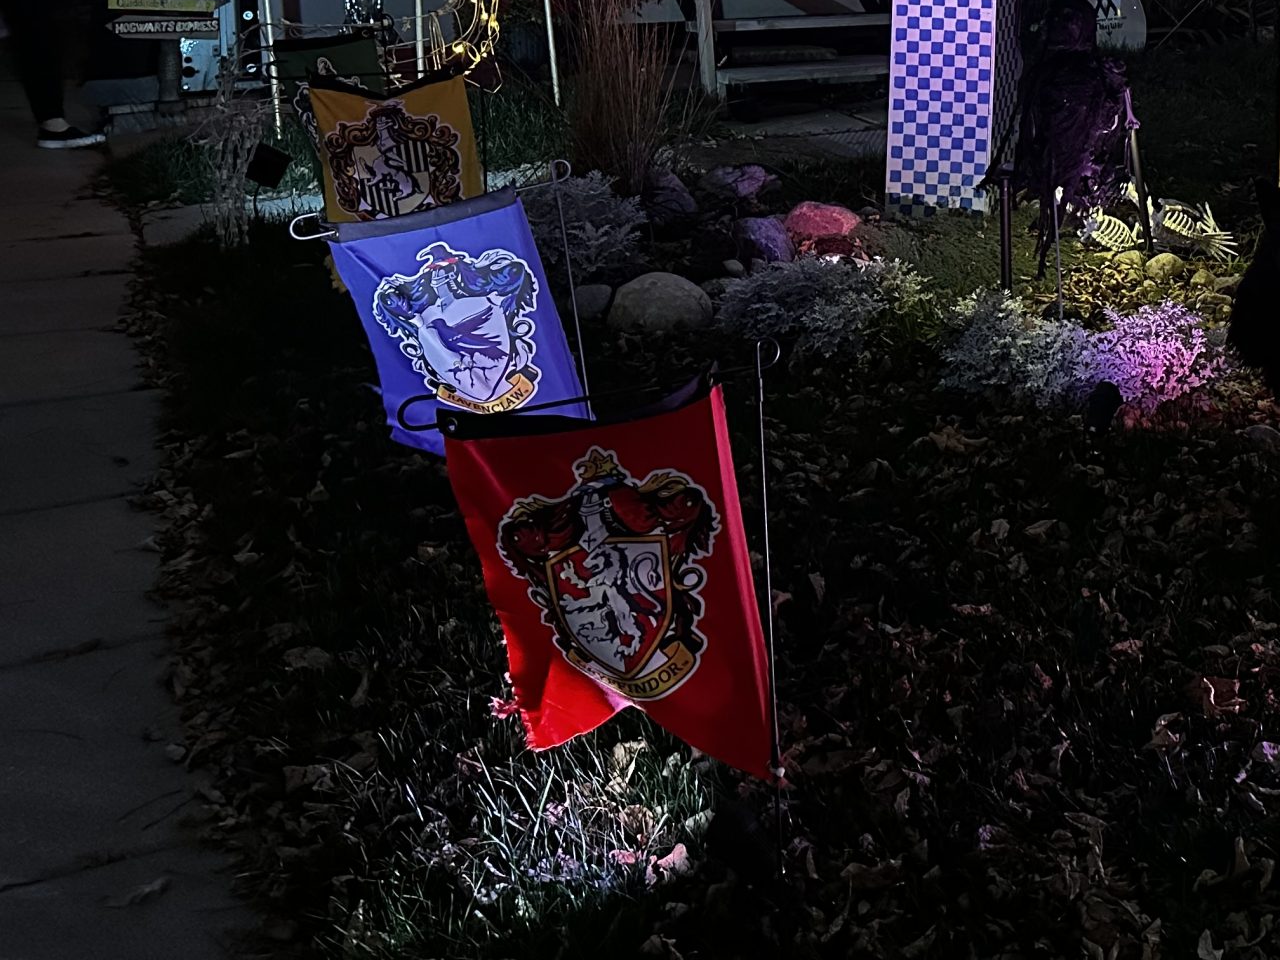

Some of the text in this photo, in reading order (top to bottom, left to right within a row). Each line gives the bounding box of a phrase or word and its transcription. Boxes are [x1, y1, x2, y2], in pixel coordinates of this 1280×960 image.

[114, 20, 219, 34] HOGWARTS EXPRESS
[447, 388, 524, 414] RAVENCLAW
